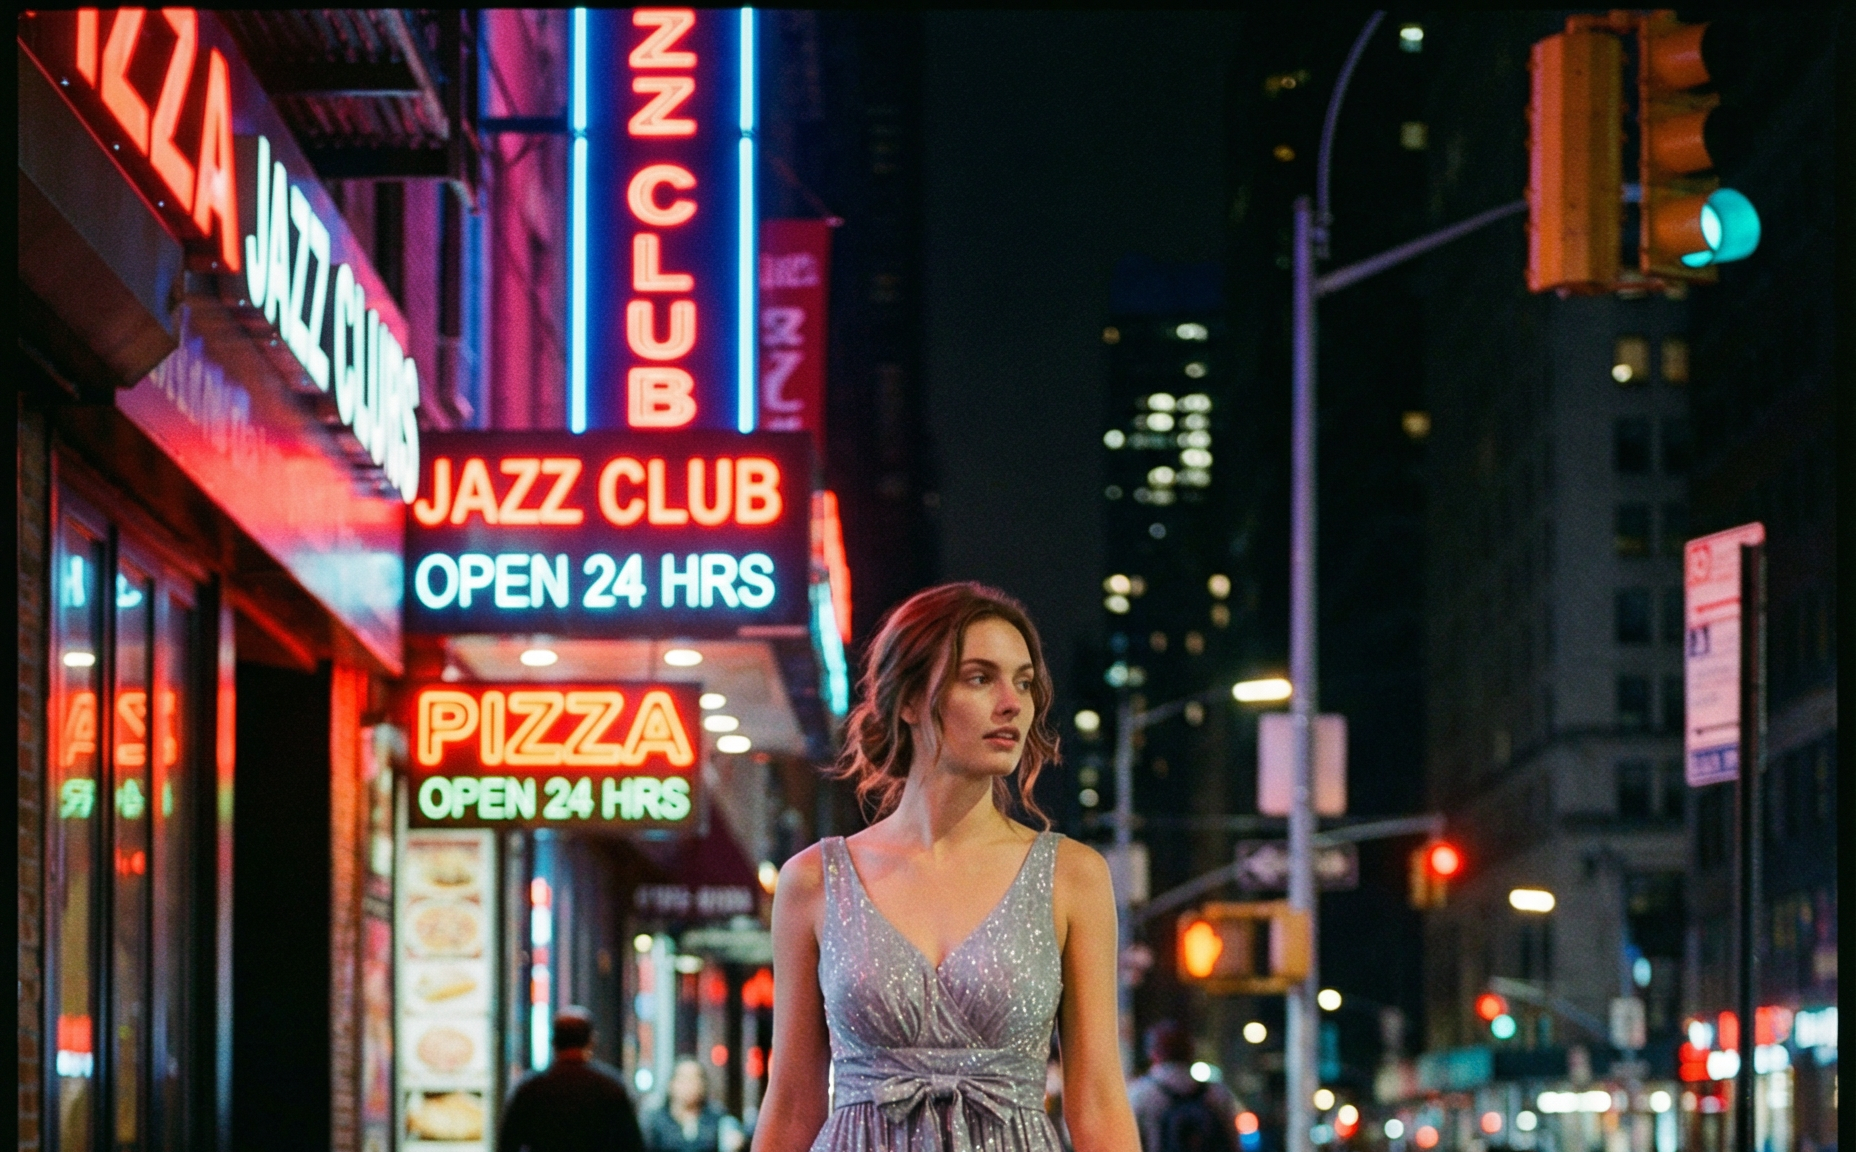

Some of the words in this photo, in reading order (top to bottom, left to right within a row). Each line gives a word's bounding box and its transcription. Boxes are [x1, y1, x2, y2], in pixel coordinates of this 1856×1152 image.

[245, 135, 330, 392] JAZZ
[627, 164, 697, 428] CLUB
[414, 457, 584, 526] JAZZ
[599, 457, 782, 526] CLUB
[415, 553, 569, 609] OPEN
[583, 553, 647, 609] 24
[661, 553, 775, 609] HRS
[417, 690, 694, 767] PIZZA
[418, 776, 537, 820] OPEN
[543, 776, 594, 820] 24
[602, 776, 691, 820] HRS
